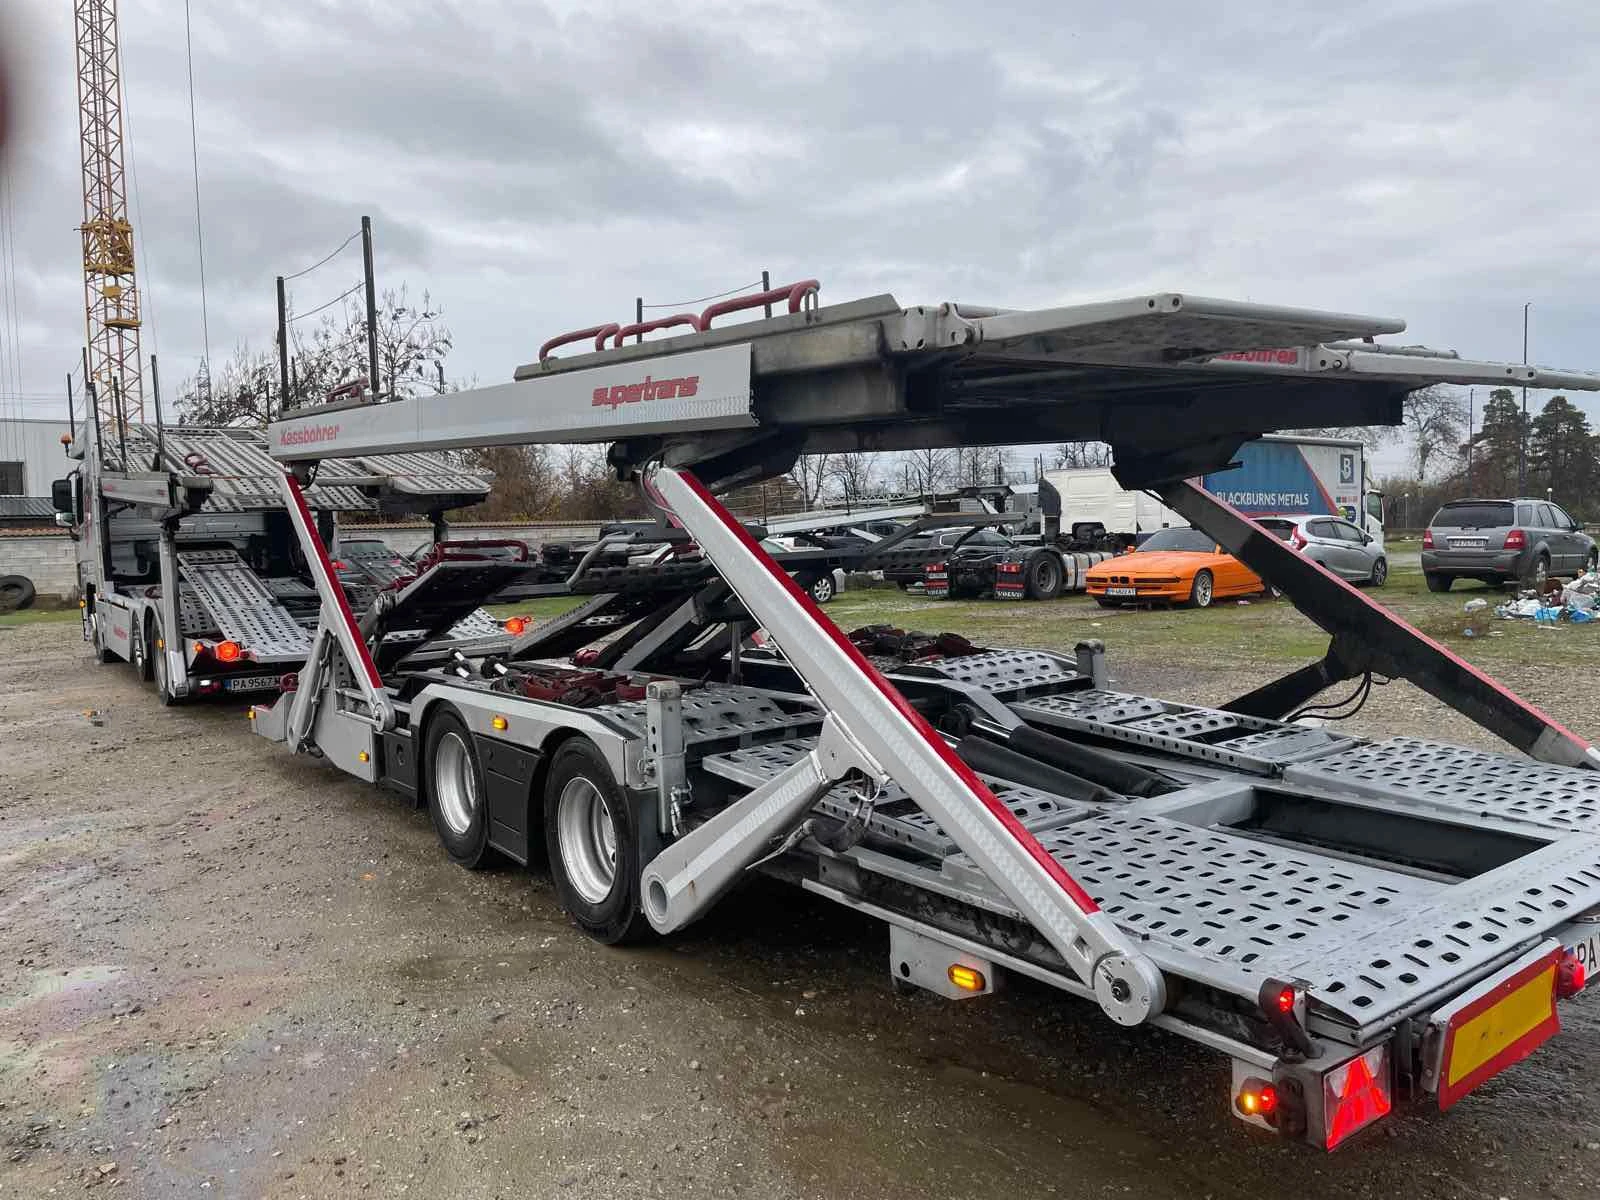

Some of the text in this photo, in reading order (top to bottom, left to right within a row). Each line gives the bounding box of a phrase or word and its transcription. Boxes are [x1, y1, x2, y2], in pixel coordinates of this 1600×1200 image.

[592, 376, 699, 409] supertrans
[1217, 491, 1309, 506] BLACKBURNS METALS
